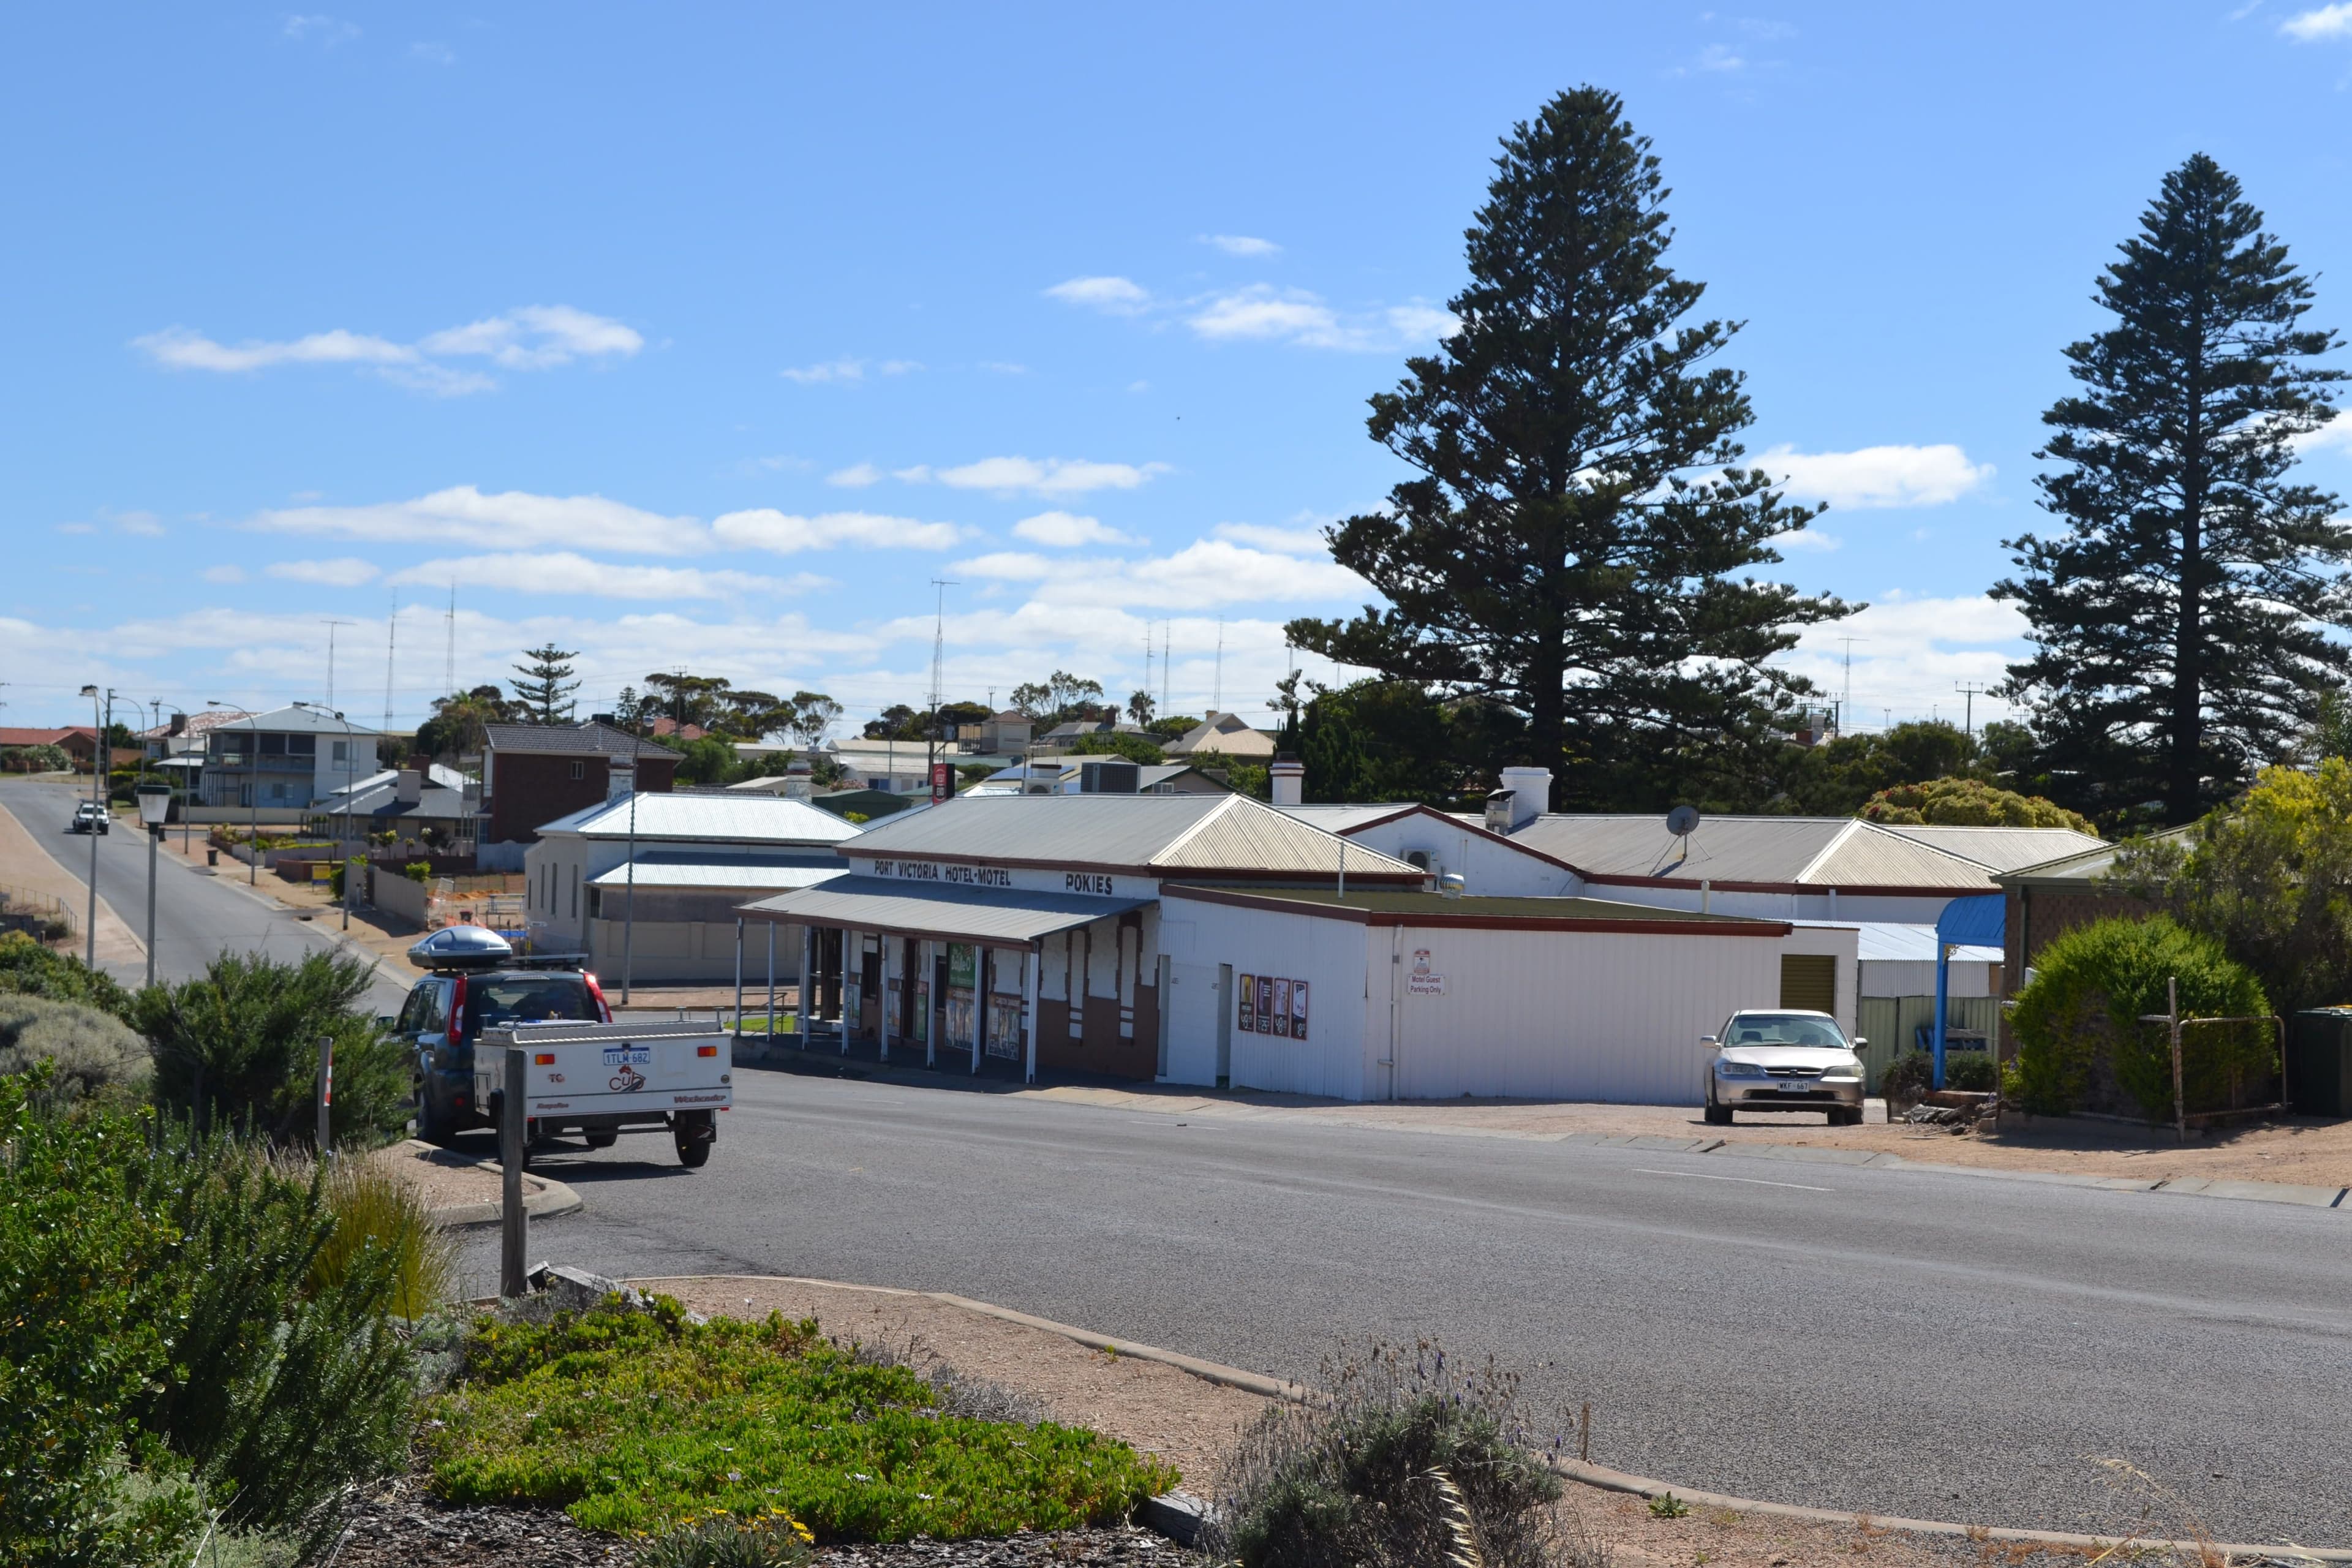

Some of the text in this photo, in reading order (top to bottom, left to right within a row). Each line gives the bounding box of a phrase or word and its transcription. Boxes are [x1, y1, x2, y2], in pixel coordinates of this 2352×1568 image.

[875, 860, 893, 876] PORT
[899, 862, 938, 881] VICTORIA
[1066, 873, 1112, 895] POKIES
[1411, 986, 1441, 995] Parking Only
